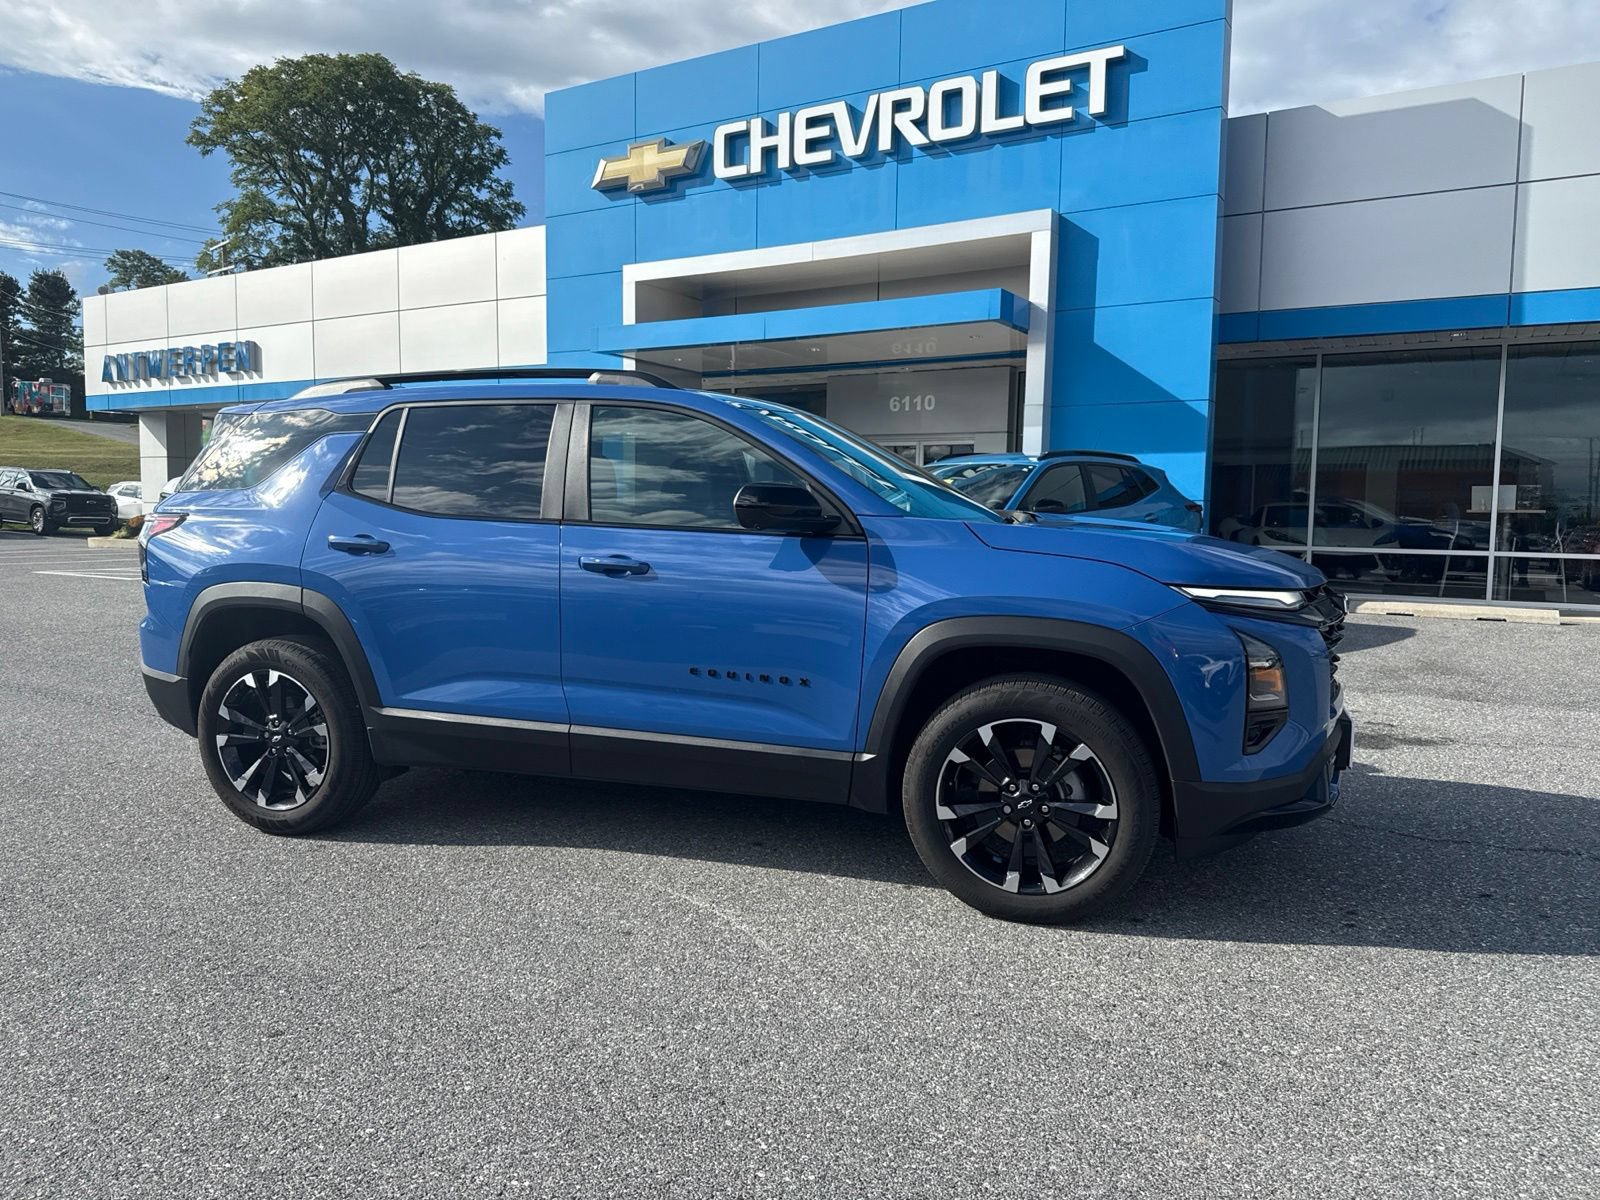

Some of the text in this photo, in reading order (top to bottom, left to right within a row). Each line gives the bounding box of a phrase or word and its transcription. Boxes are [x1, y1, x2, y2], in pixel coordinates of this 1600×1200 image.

[713, 45, 1126, 181] CHEVROLET
[101, 340, 254, 383] ANTWERPEN
[889, 394, 936, 412] 6110
[689, 667, 811, 687] EQUINOX
